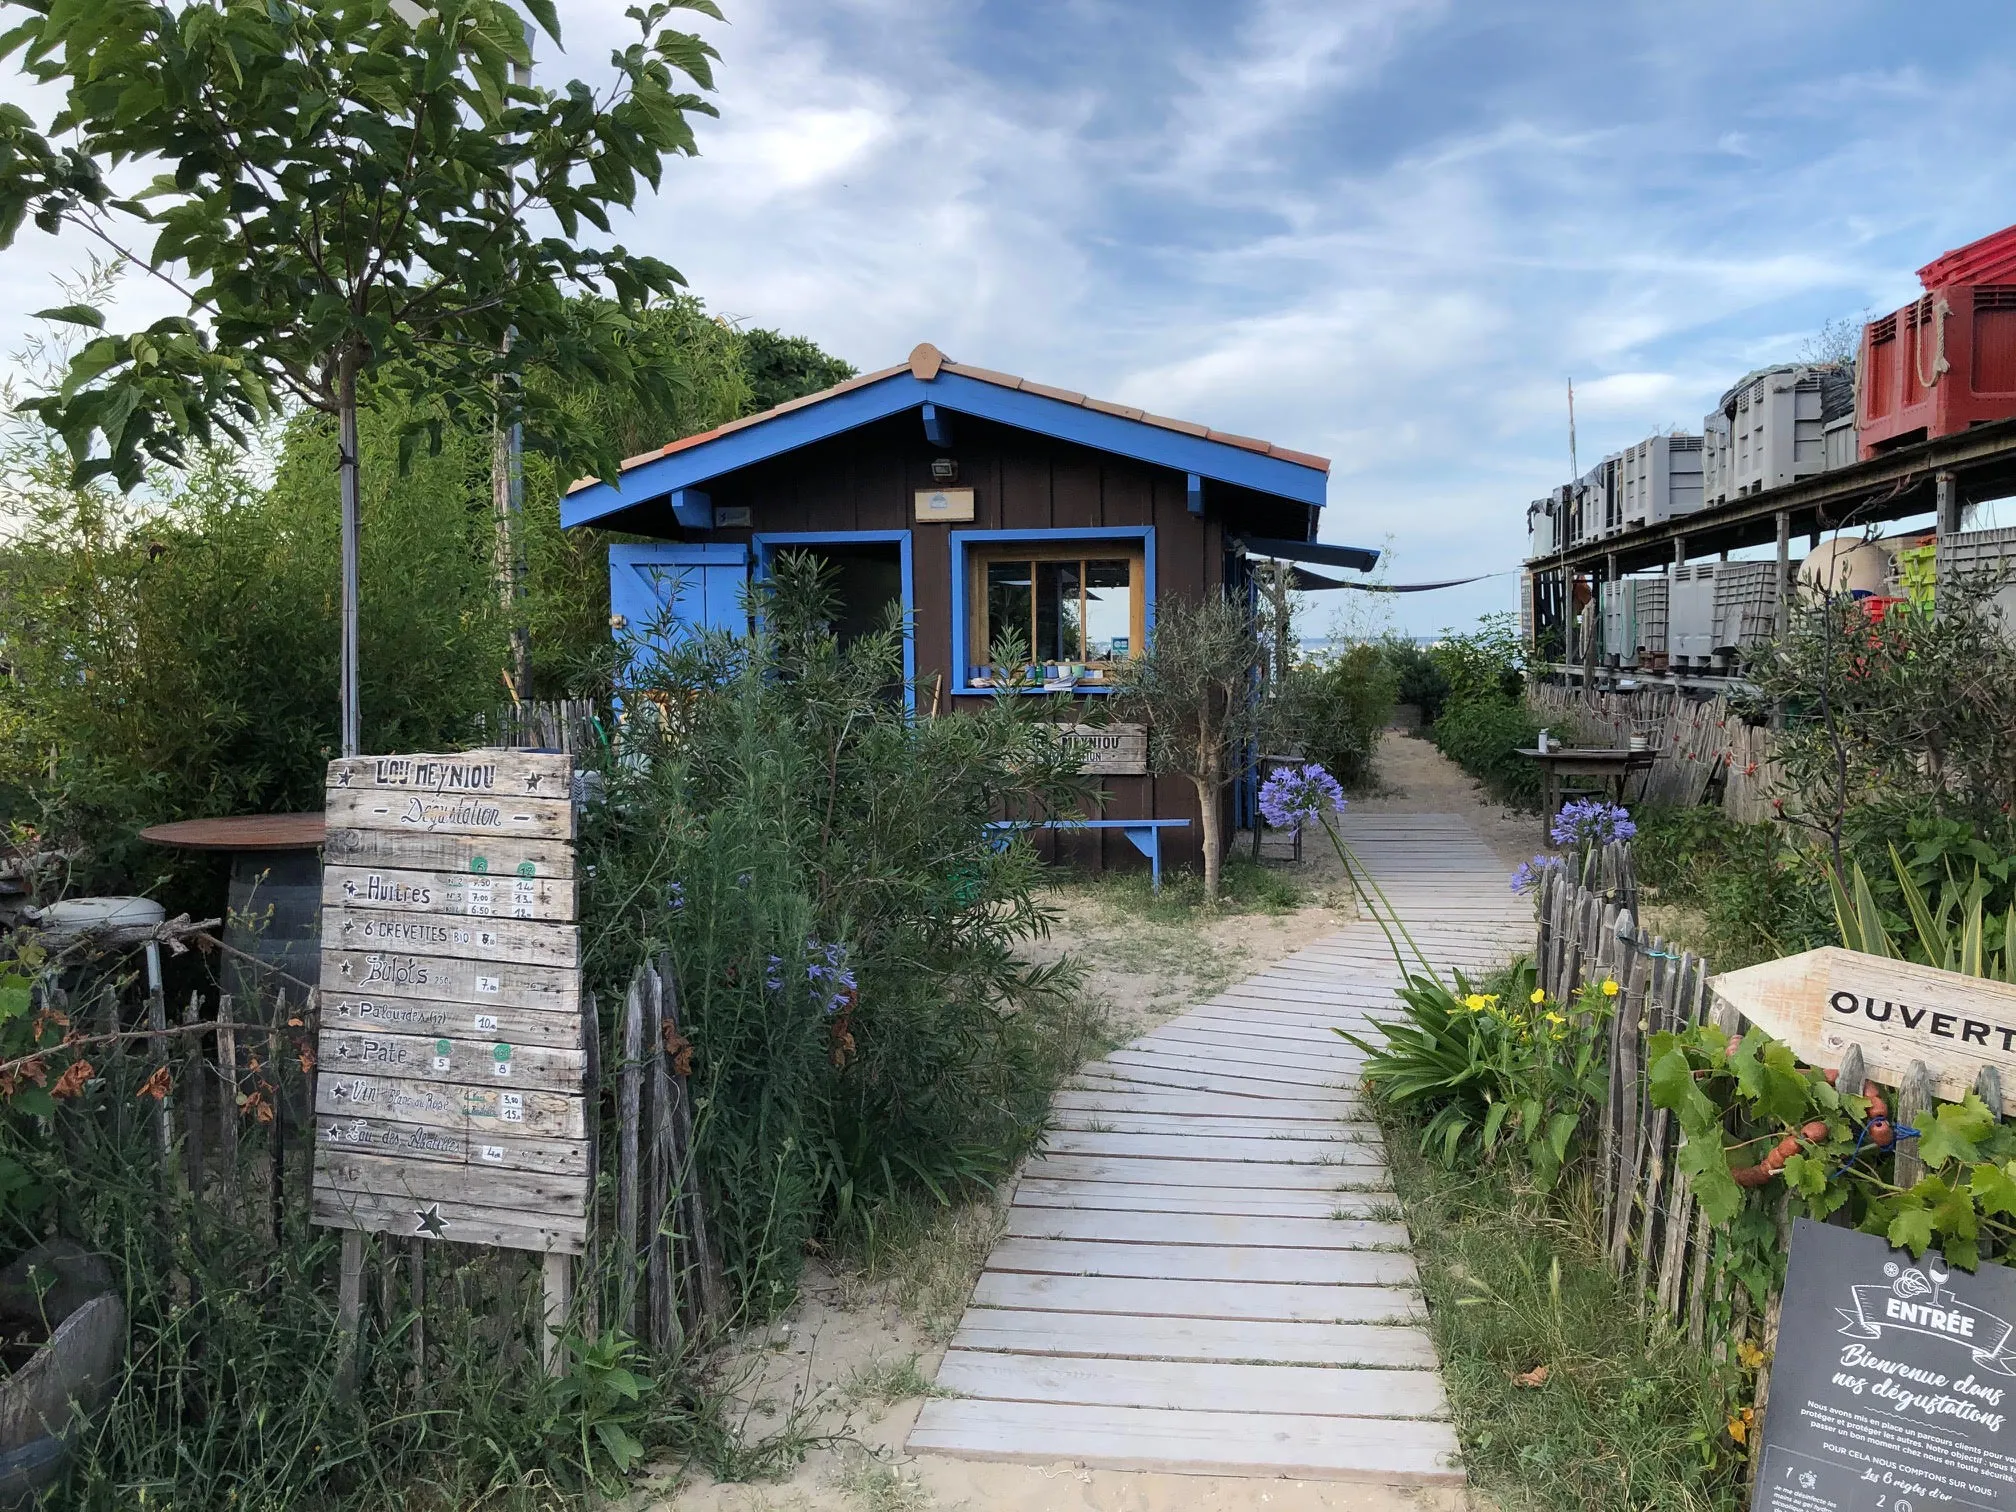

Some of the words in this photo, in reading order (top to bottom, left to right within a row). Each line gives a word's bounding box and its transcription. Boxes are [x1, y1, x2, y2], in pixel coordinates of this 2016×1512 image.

[376, 760, 411, 783] LOU
[365, 922, 373, 936] 6
[379, 923, 447, 942] CREVETTES
[453, 932, 469, 944] BIO
[360, 957, 428, 986] Bulots
[1829, 991, 2016, 1051] OUVERT
[353, 1080, 377, 1102] Vin
[346, 1120, 373, 1142] Eau
[382, 1127, 400, 1146] des
[1886, 1298, 1975, 1338] ENTRÉE
[1840, 1344, 1950, 1387] Bienvenue
[1953, 1375, 2005, 1406] dans
[1832, 1372, 1868, 1395] nos
[1871, 1378, 2007, 1432] dégustations
[1800, 1408, 1836, 1423] protéger
[1836, 1418, 1846, 1427] et
[1846, 1421, 1882, 1436] protéger
[1883, 1430, 1895, 1440] les
[1896, 1435, 1924, 1449] autres.
[1925, 1442, 1950, 1456] Notre
[1950, 1450, 1983, 1464] objectif
[1988, 1461, 2009, 1472] vous
[1807, 1400, 1828, 1412] Nous
[1828, 1407, 1853, 1419] avons
[1853, 1414, 1868, 1423] mis
[1869, 1418, 1880, 1426] en
[1881, 1421, 1904, 1433] place
[1904, 1428, 1916, 1436] un
[1917, 1431, 1953, 1447] parcours
[1954, 1442, 1982, 1455] clients
[1983, 1450, 2003, 1460] pour
[1810, 1420, 1837, 1433] passer
[1837, 1428, 1849, 1437] un
[1849, 1430, 1866, 1442] bon
[1866, 1437, 1901, 1452] moment
[1902, 1446, 1922, 1458] chez
[1922, 1453, 1943, 1464] nous
[1944, 1459, 1956, 1467] en
[1956, 1461, 1979, 1474] toute
[1980, 1468, 2016, 1483] sécurité.
[1822, 1441, 1847, 1455] POUR
[1848, 1449, 1871, 1463] CELA
[1872, 1456, 1897, 1470] NOUS
[1898, 1464, 1947, 1484] COMPTONS
[1948, 1478, 1967, 1489] SUR
[1968, 1483, 1992, 1497] VOUS
[1860, 1467, 1881, 1483] Les
[1882, 1471, 1893, 1484] 6
[1892, 1479, 1928, 1497] règles
[1928, 1487, 1953, 1501] d'or
[1876, 1494, 1886, 1508] 2
